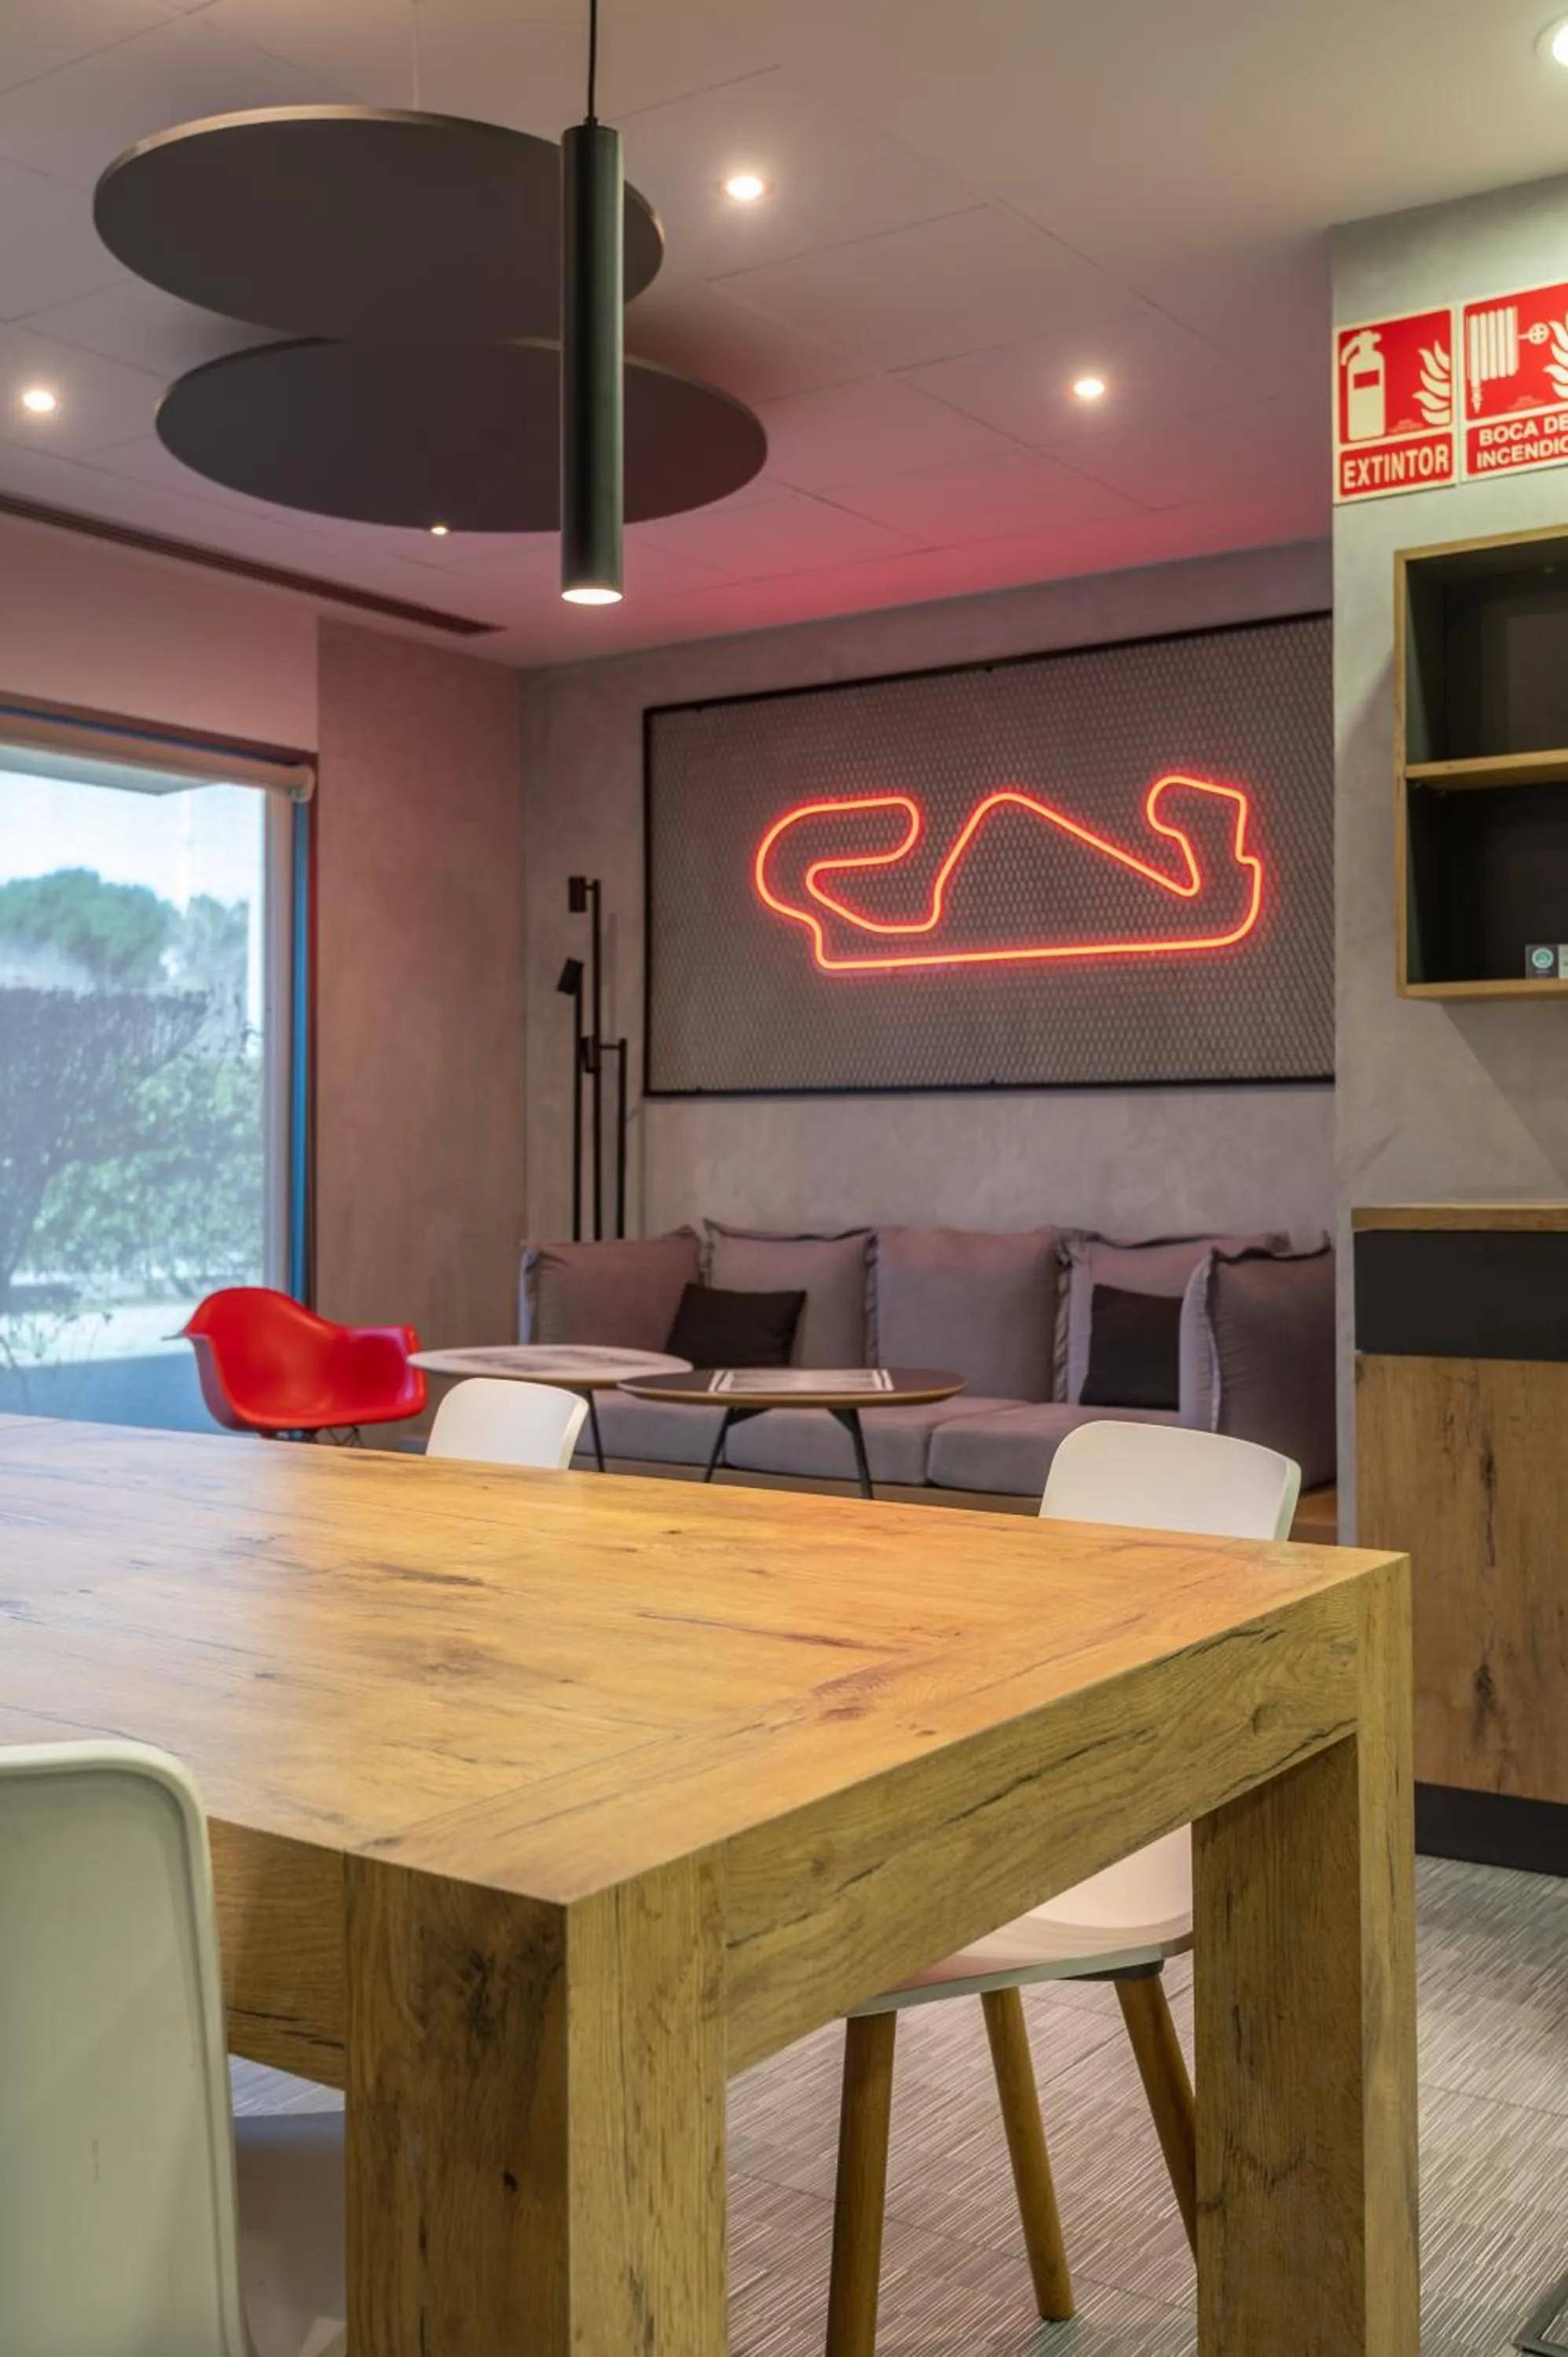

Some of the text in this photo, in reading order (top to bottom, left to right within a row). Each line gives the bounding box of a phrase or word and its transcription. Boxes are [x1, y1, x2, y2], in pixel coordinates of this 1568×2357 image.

[1479, 413, 1568, 446] BOCA DE
[1344, 444, 1449, 489] EXTINTOR
